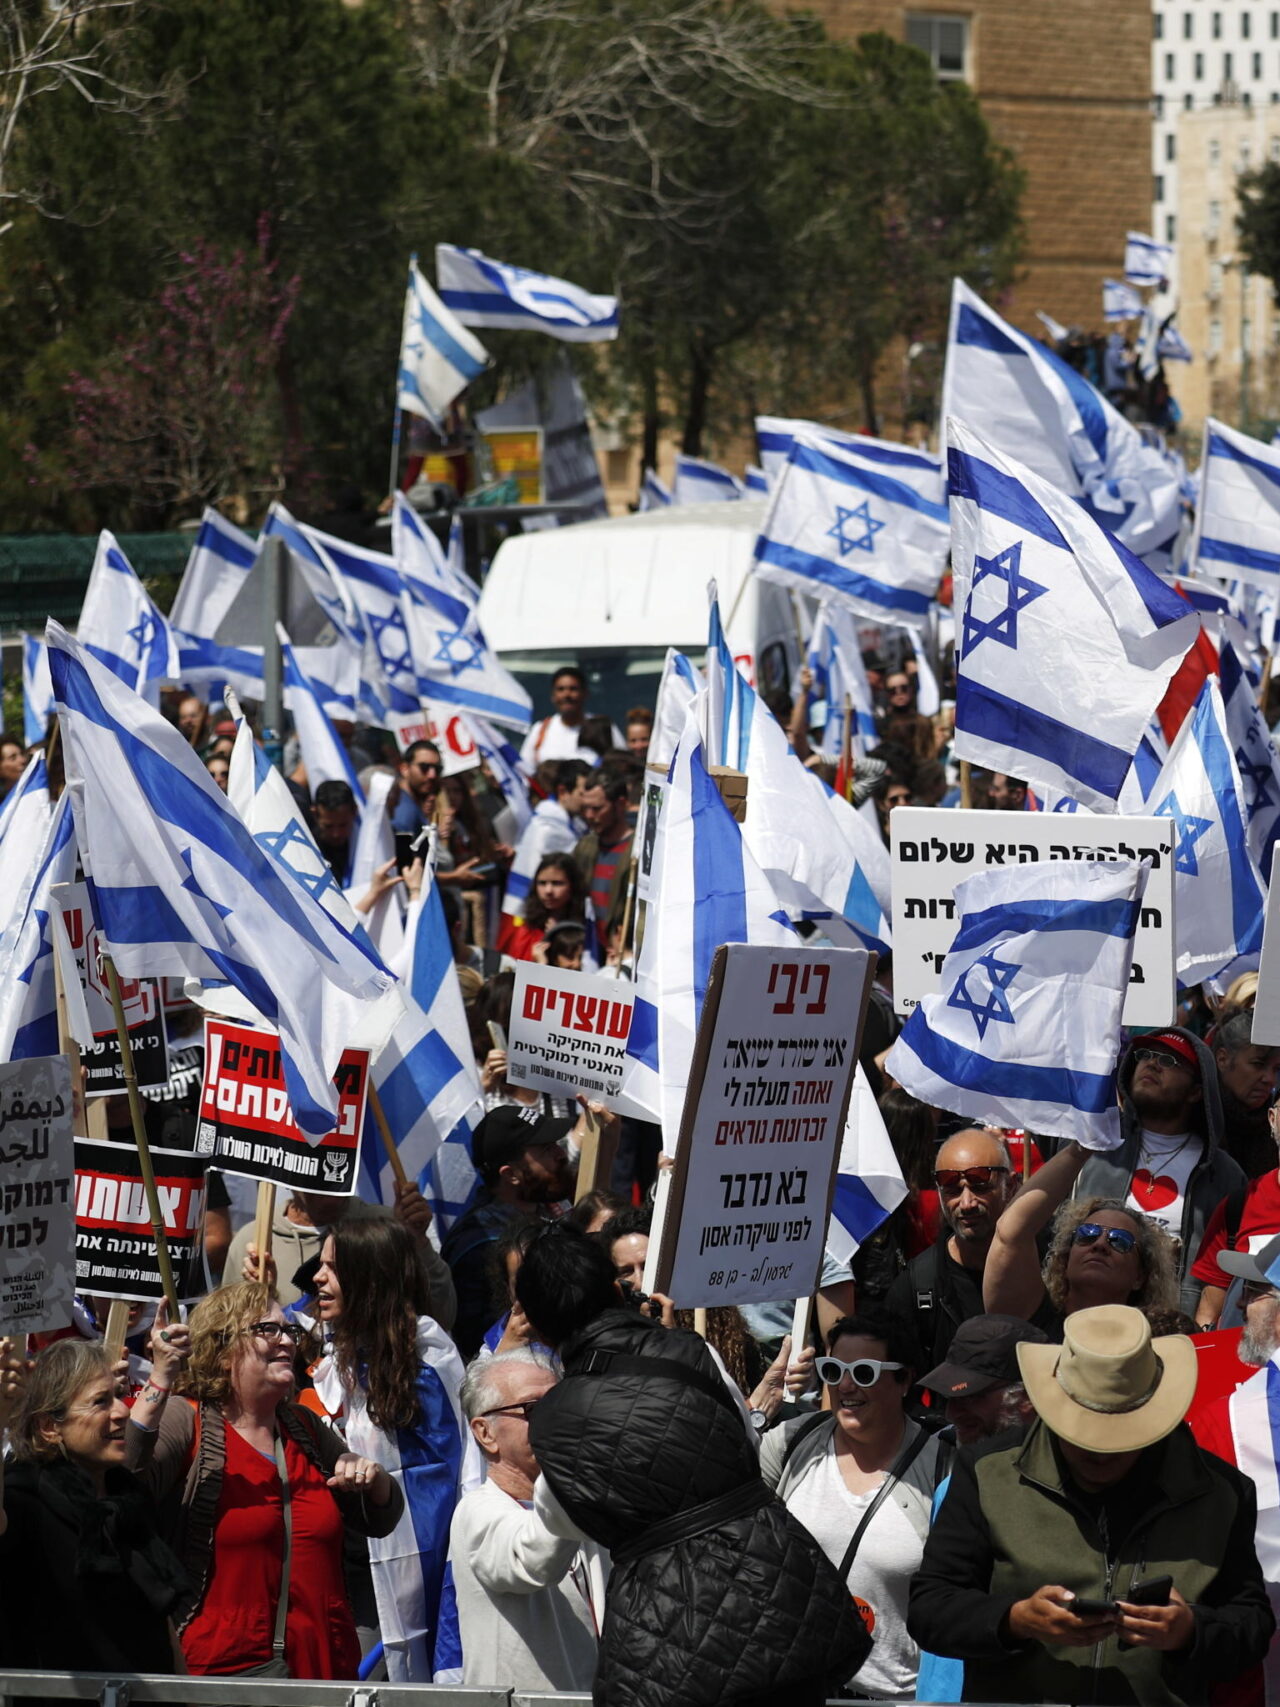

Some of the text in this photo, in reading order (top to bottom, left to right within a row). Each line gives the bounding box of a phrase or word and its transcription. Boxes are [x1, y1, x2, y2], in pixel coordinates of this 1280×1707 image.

[900, 837, 974, 863] שלום
[985, 844, 1039, 864] היא
[767, 963, 831, 1015] ביבי
[522, 984, 632, 1040] עוצרים
[514, 1040, 623, 1076] האנטי דמוקרטית
[547, 1032, 625, 1060] את החקיקה
[723, 1038, 847, 1069] אני שורד שואה
[724, 1076, 833, 1107] ואתה מעלה לי
[714, 1117, 827, 1146] זכרונות נוראים
[252, 1143, 285, 1168] לאיכות
[284, 1151, 318, 1176] התנועה
[719, 1171, 773, 1209] נדבר
[76, 1233, 103, 1250] את
[699, 1216, 812, 1255] לפני שיקרה אסון
[709, 1271, 723, 1286] 88
